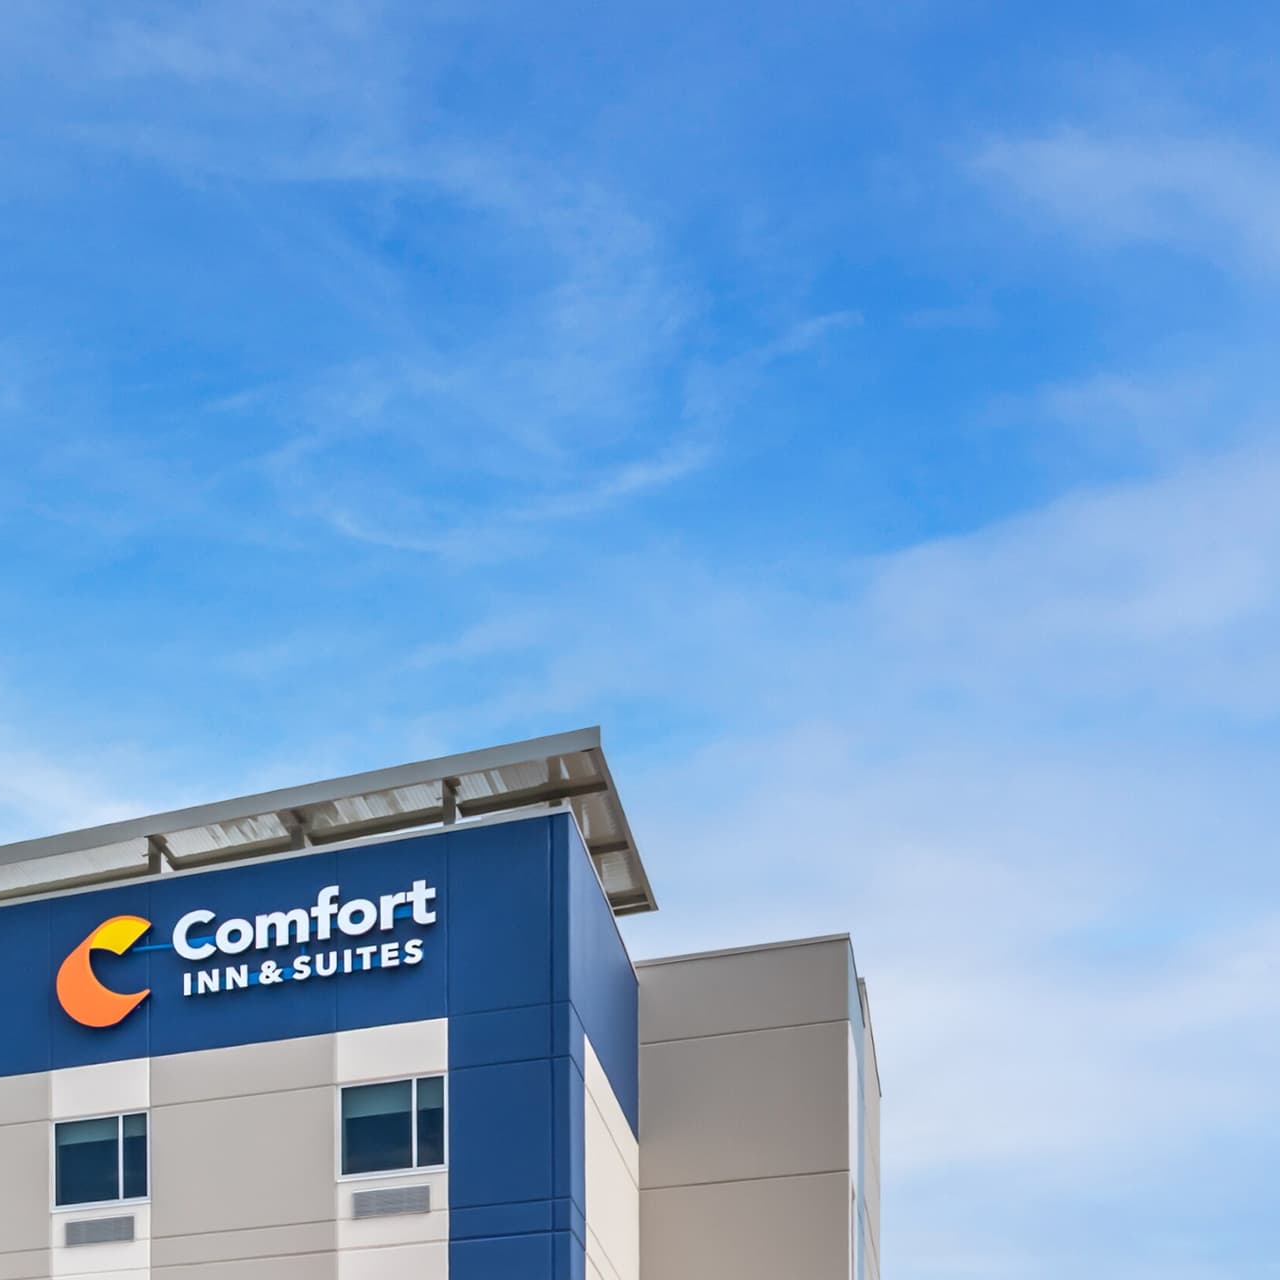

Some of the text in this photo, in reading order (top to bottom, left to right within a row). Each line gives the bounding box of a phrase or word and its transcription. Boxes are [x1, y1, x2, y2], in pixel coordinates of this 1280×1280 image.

[172, 879, 437, 960] Comfort
[183, 939, 425, 996] INN & SUITES
